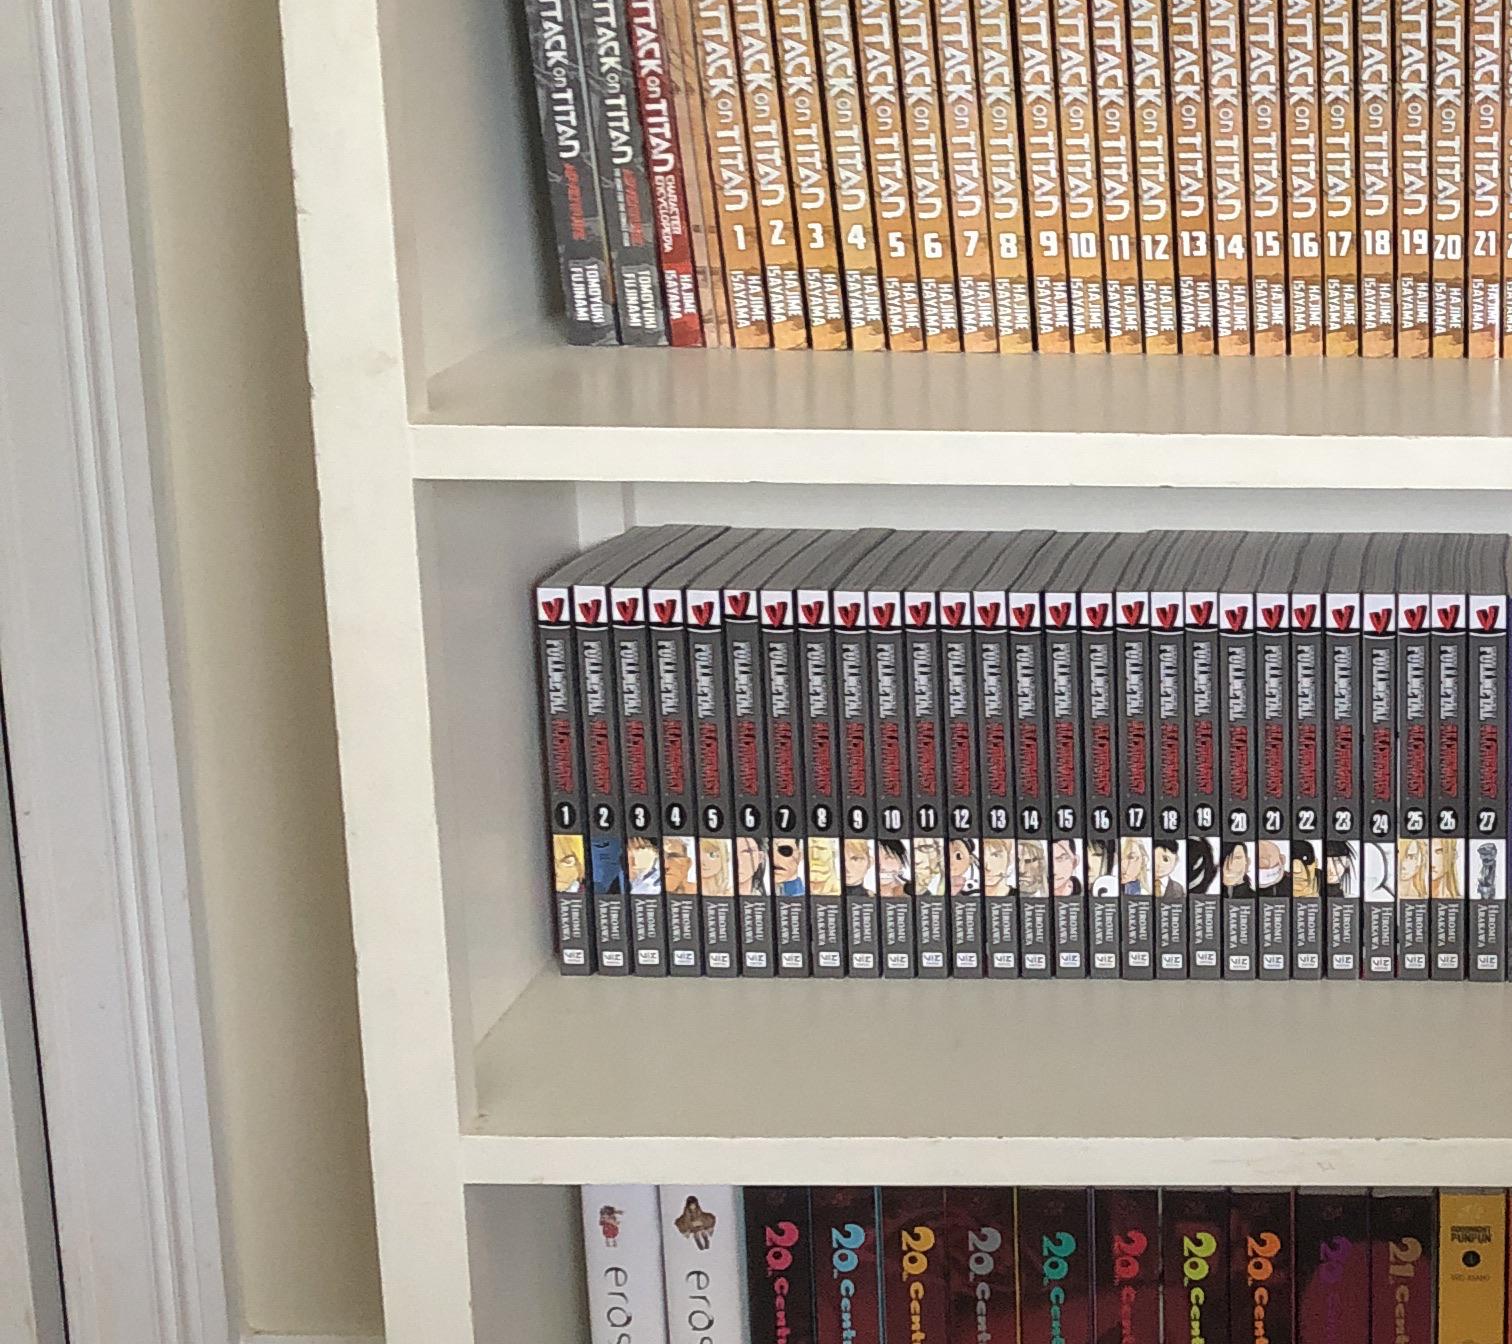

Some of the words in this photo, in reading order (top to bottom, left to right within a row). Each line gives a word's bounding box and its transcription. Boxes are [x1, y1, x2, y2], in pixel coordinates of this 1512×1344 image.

[646, 76, 661, 97] on
[717, 98, 734, 123] on
[1069, 107, 1084, 131] on
[645, 98, 675, 173] TITAN
[716, 125, 749, 211] TITAN
[1066, 133, 1094, 219] TITAN
[734, 225, 746, 250] 1
[808, 223, 824, 248] 3
[1070, 232, 1097, 258] 10
[1434, 234, 1462, 260] 20
[571, 267, 589, 321] FUJINAMI
[663, 270, 682, 320] ISAYAMA
[680, 274, 697, 314] HAJIME
[730, 271, 750, 328] ISAYAMA
[748, 275, 765, 322] HAJIME
[546, 639, 568, 714] FULLMETAL
[562, 806, 569, 825] 1
[1373, 814, 1388, 834] 24
[1480, 812, 1495, 831] 27
[560, 900, 570, 941] ARAKAWA
